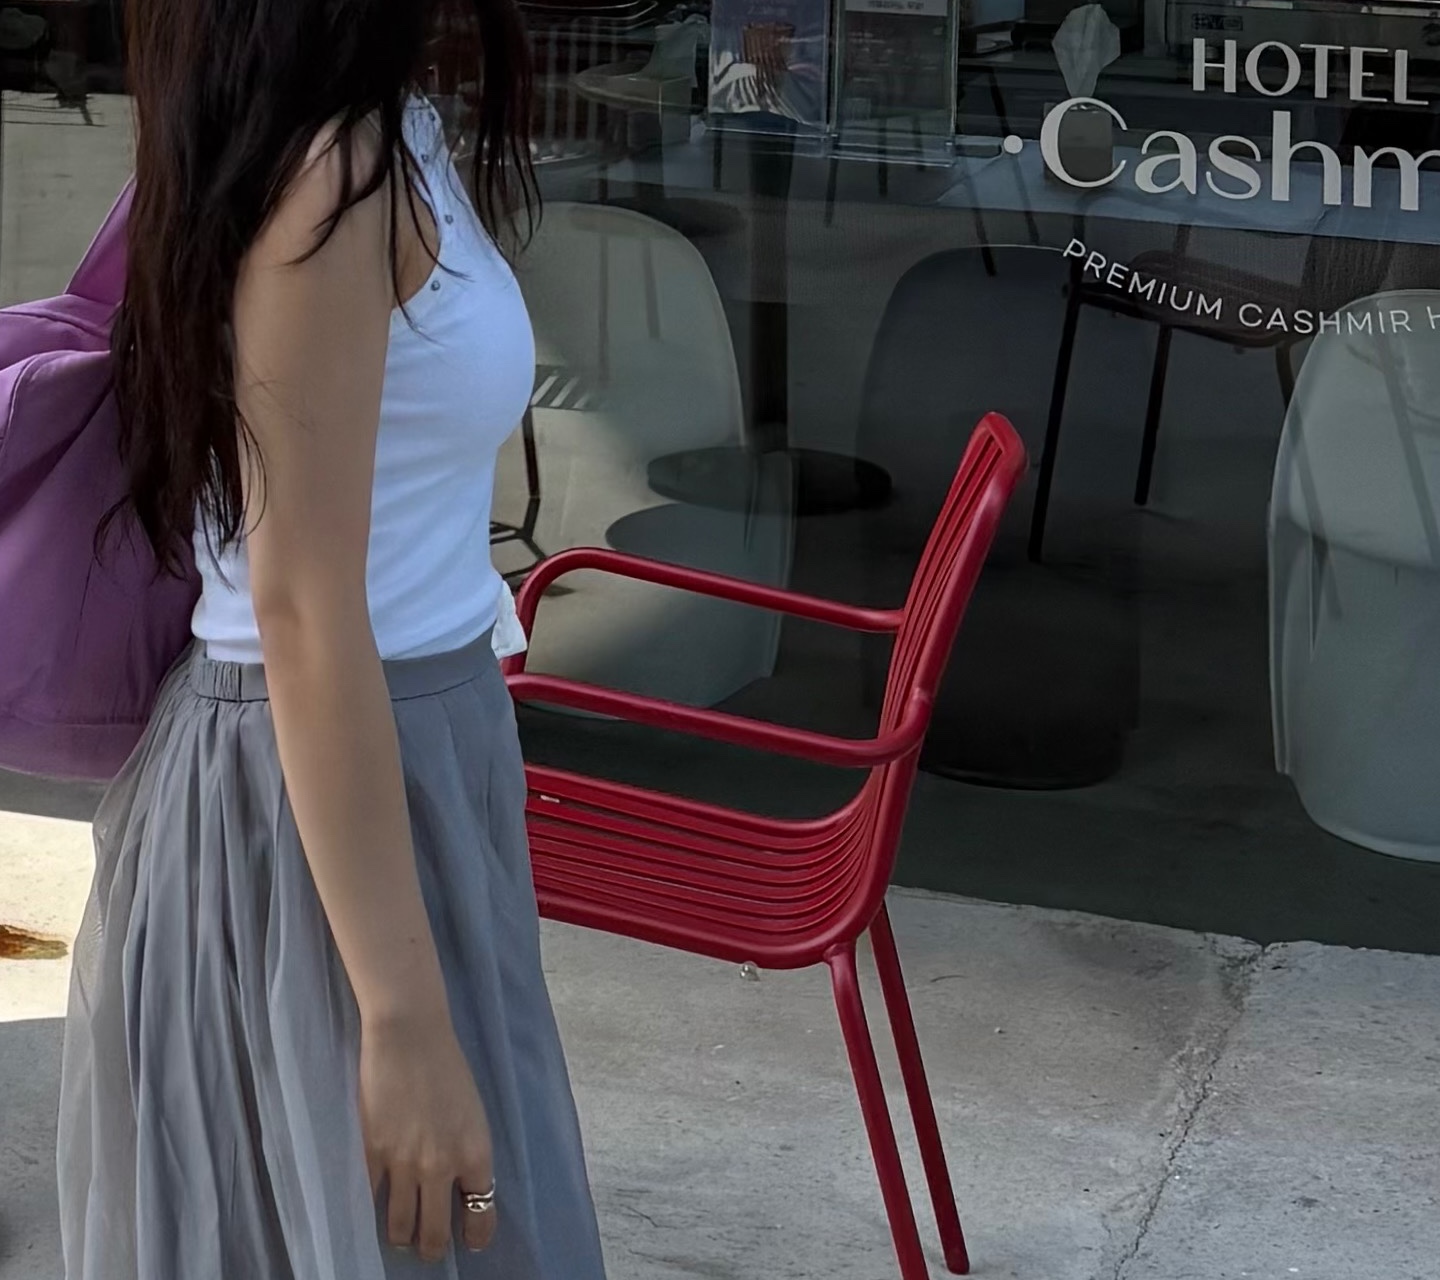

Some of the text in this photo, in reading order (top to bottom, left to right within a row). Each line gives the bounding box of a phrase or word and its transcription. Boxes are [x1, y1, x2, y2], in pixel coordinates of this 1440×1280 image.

[1192, 37, 1429, 106] HOTEL
[1063, 237, 1222, 320] PREMIUM
[1238, 303, 1412, 335] CASHMIR
